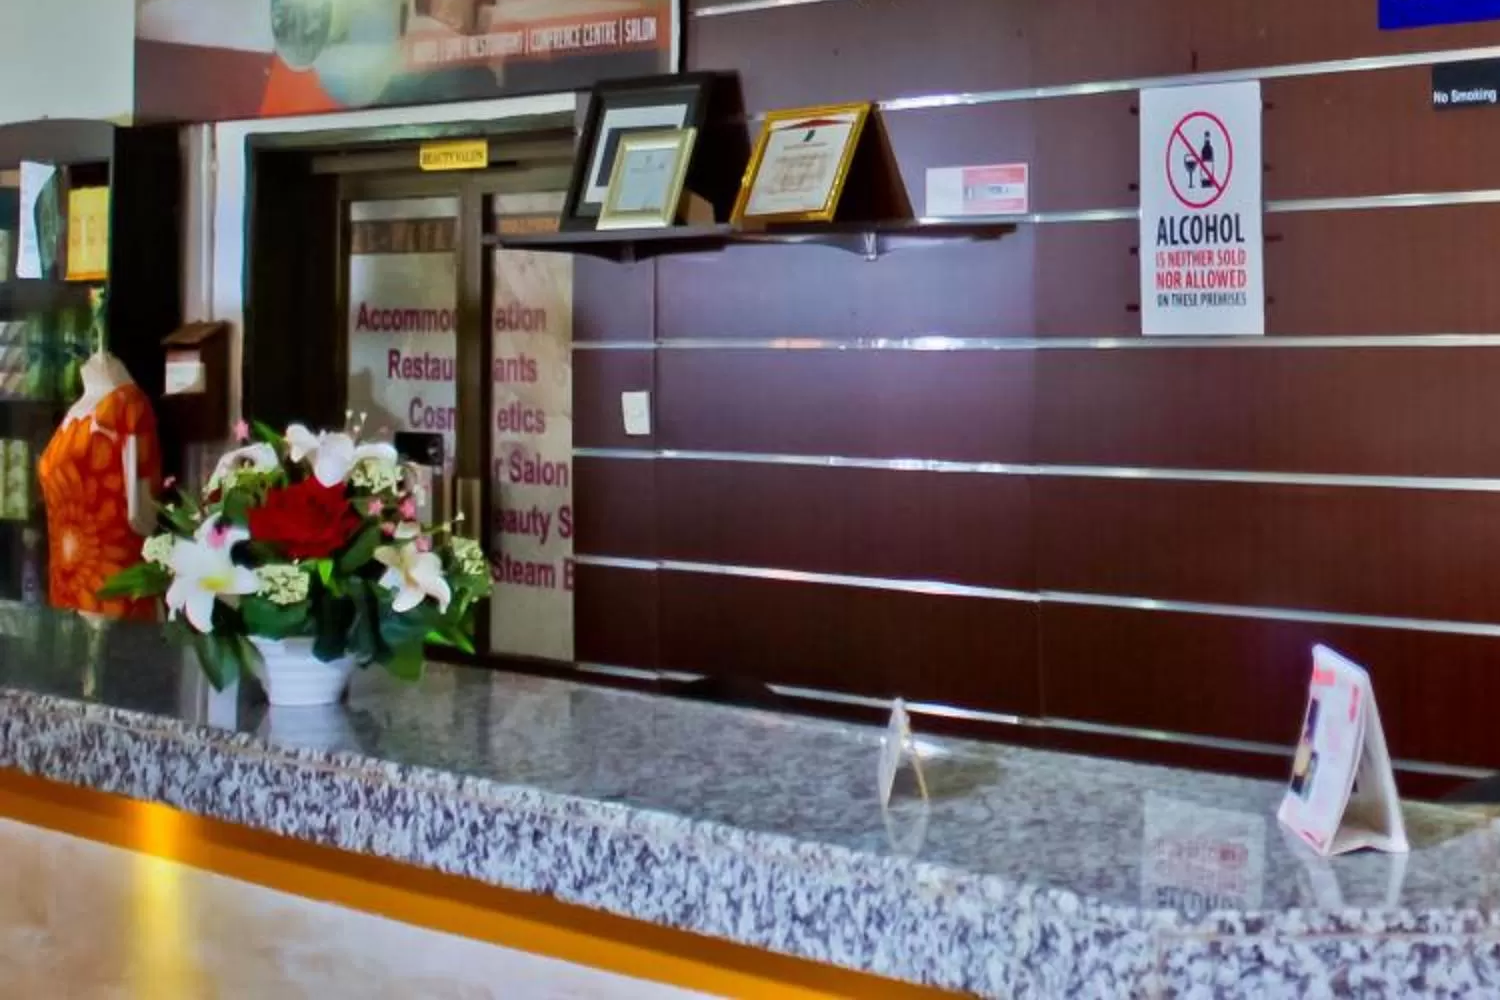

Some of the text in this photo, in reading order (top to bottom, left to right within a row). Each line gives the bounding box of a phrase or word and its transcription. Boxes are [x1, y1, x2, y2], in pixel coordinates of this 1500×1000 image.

[625, 16, 657, 42] SALON
[1433, 87, 1497, 104] No Smoking
[1156, 212, 1246, 246] ALCOHOL
[1156, 248, 1246, 268] IS NEITHER SOLD
[1156, 268, 1247, 290] NOR ALLOWED
[1157, 291, 1247, 308] ON THESE PREMISES
[509, 450, 569, 487] Salon
[494, 504, 552, 545] eauty
[492, 552, 556, 589] Steam
